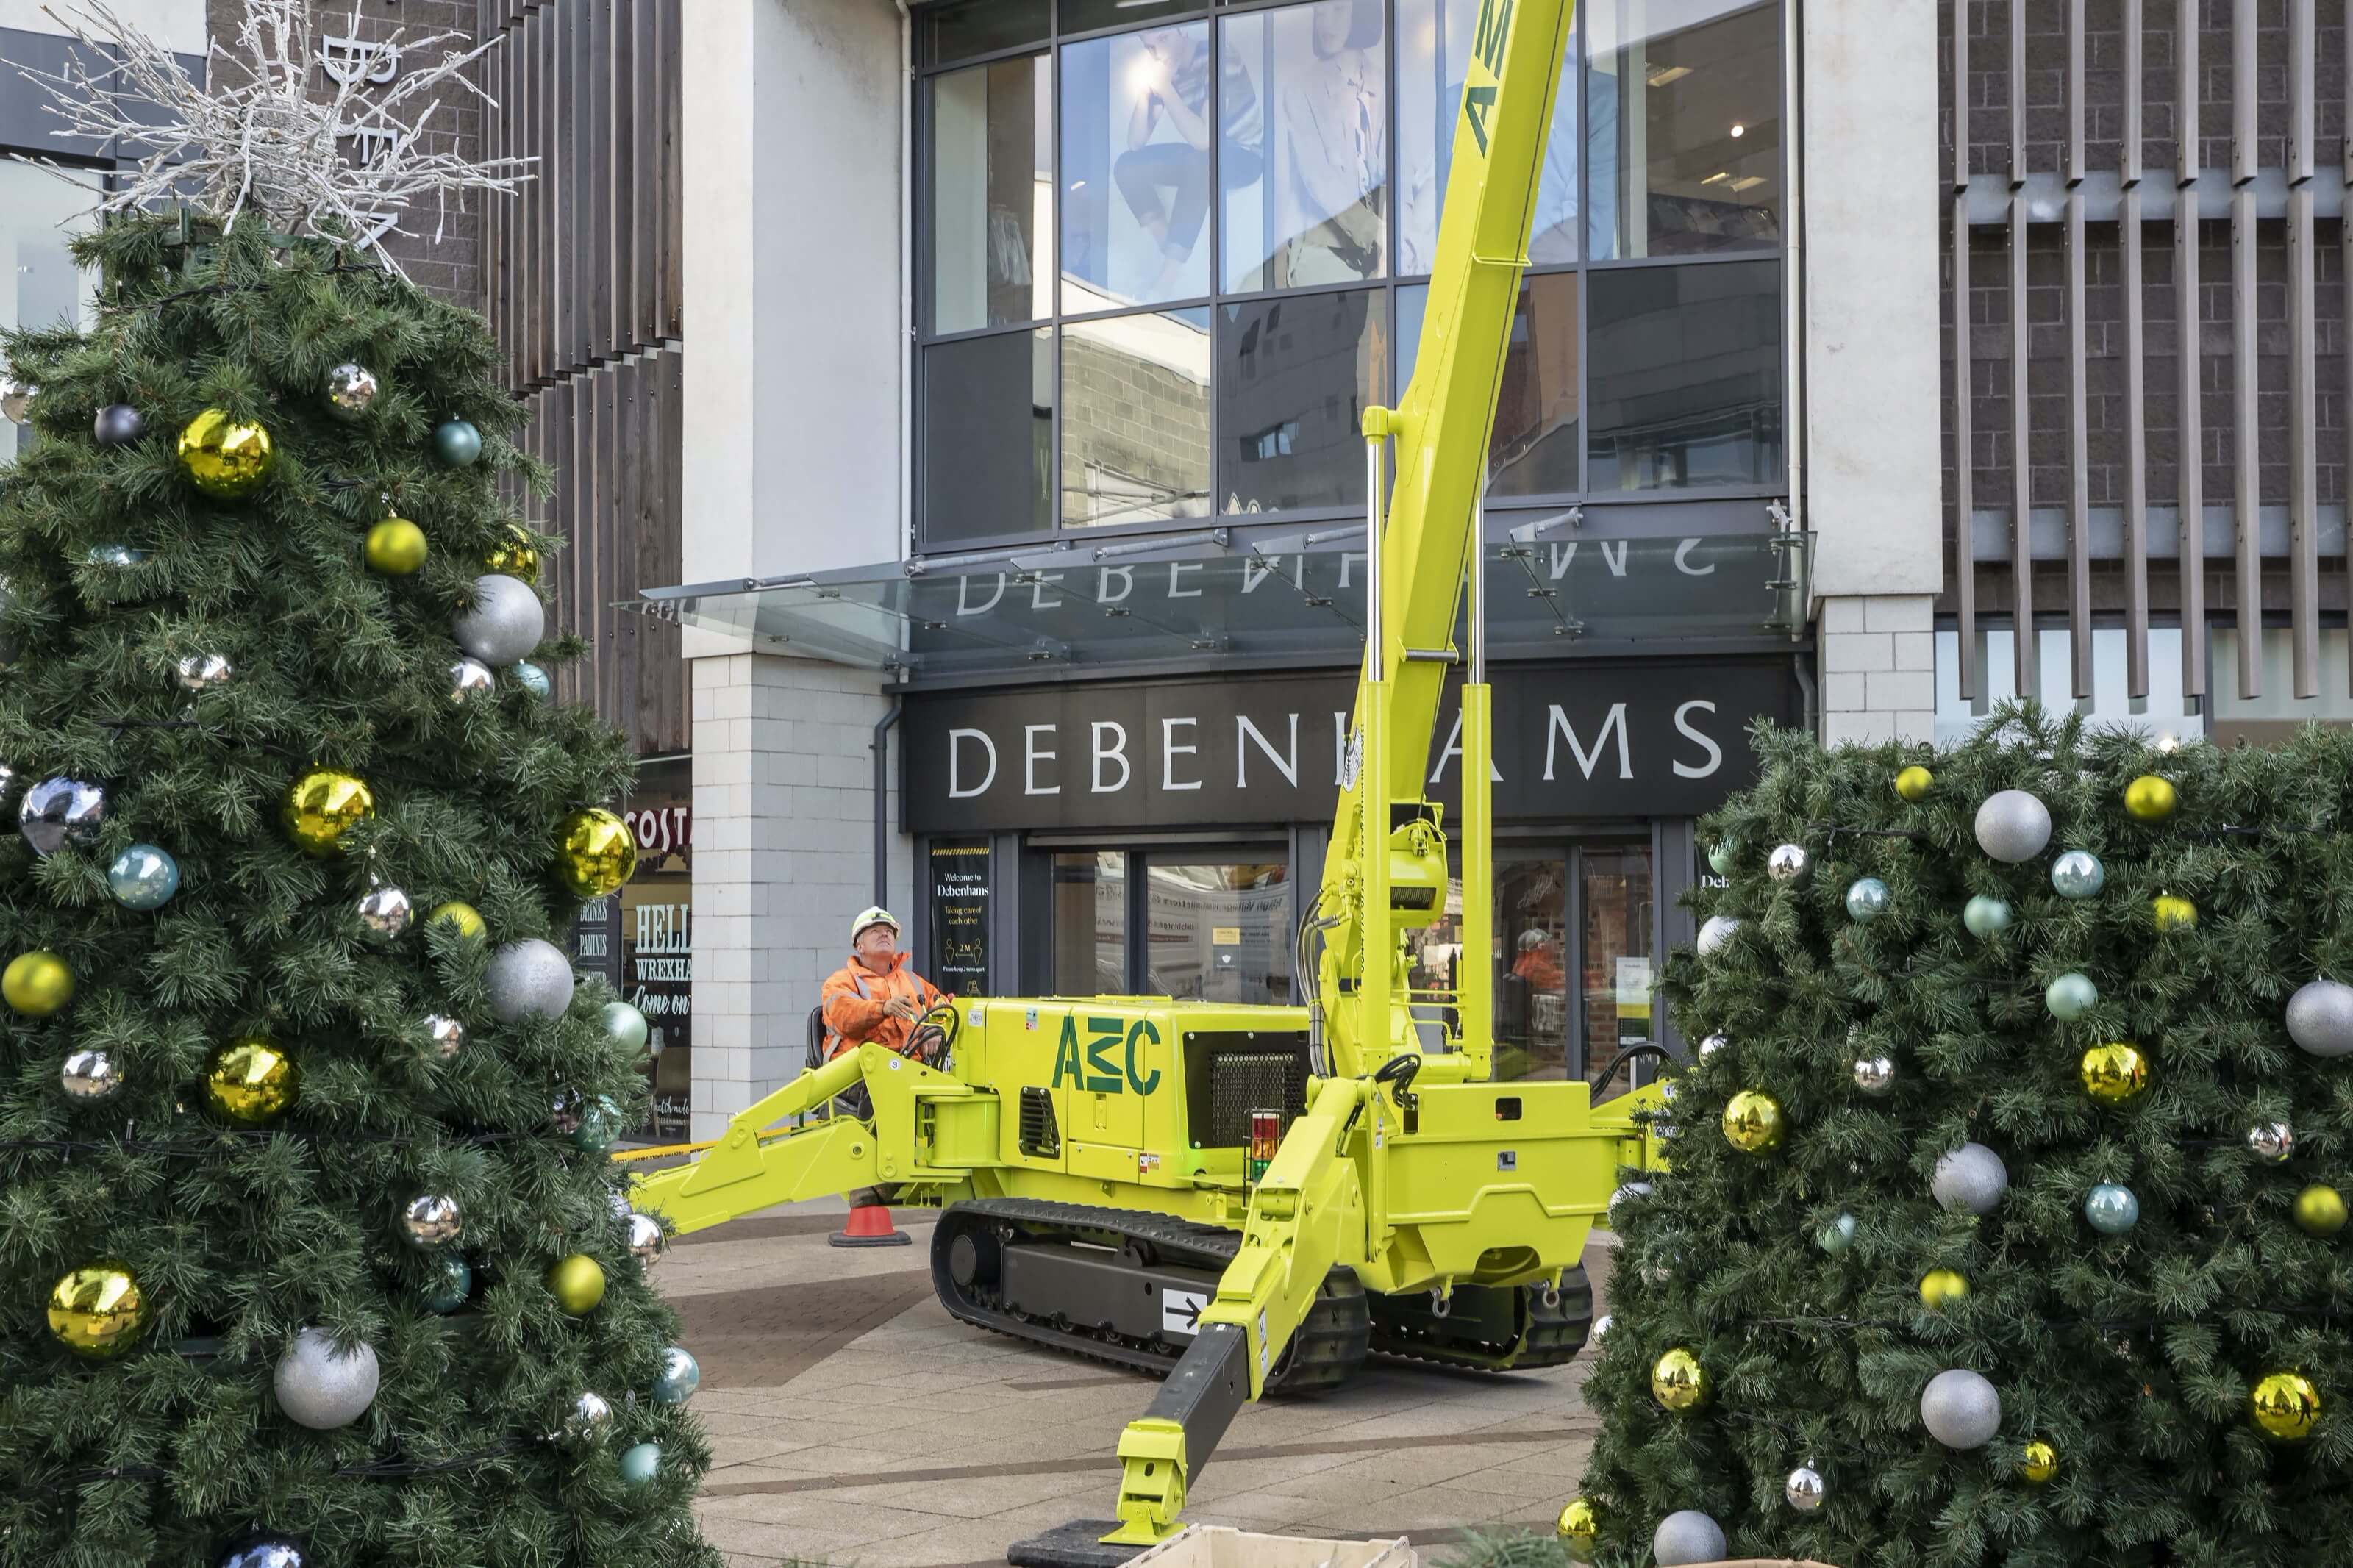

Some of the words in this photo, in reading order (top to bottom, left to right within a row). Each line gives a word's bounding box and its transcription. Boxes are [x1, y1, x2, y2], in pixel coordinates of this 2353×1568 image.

[624, 807, 692, 853] OST
[944, 873, 974, 882] Welcome
[974, 873, 982, 882] to
[938, 884, 989, 897] Debenhams
[944, 906, 963, 915] Taking
[976, 906, 982, 914] of
[949, 917, 963, 925] each
[963, 917, 978, 925] other
[579, 934, 607, 957] PANINIS
[960, 944, 964, 952] 2
[965, 944, 971, 952] M
[629, 984, 670, 1014] Come
